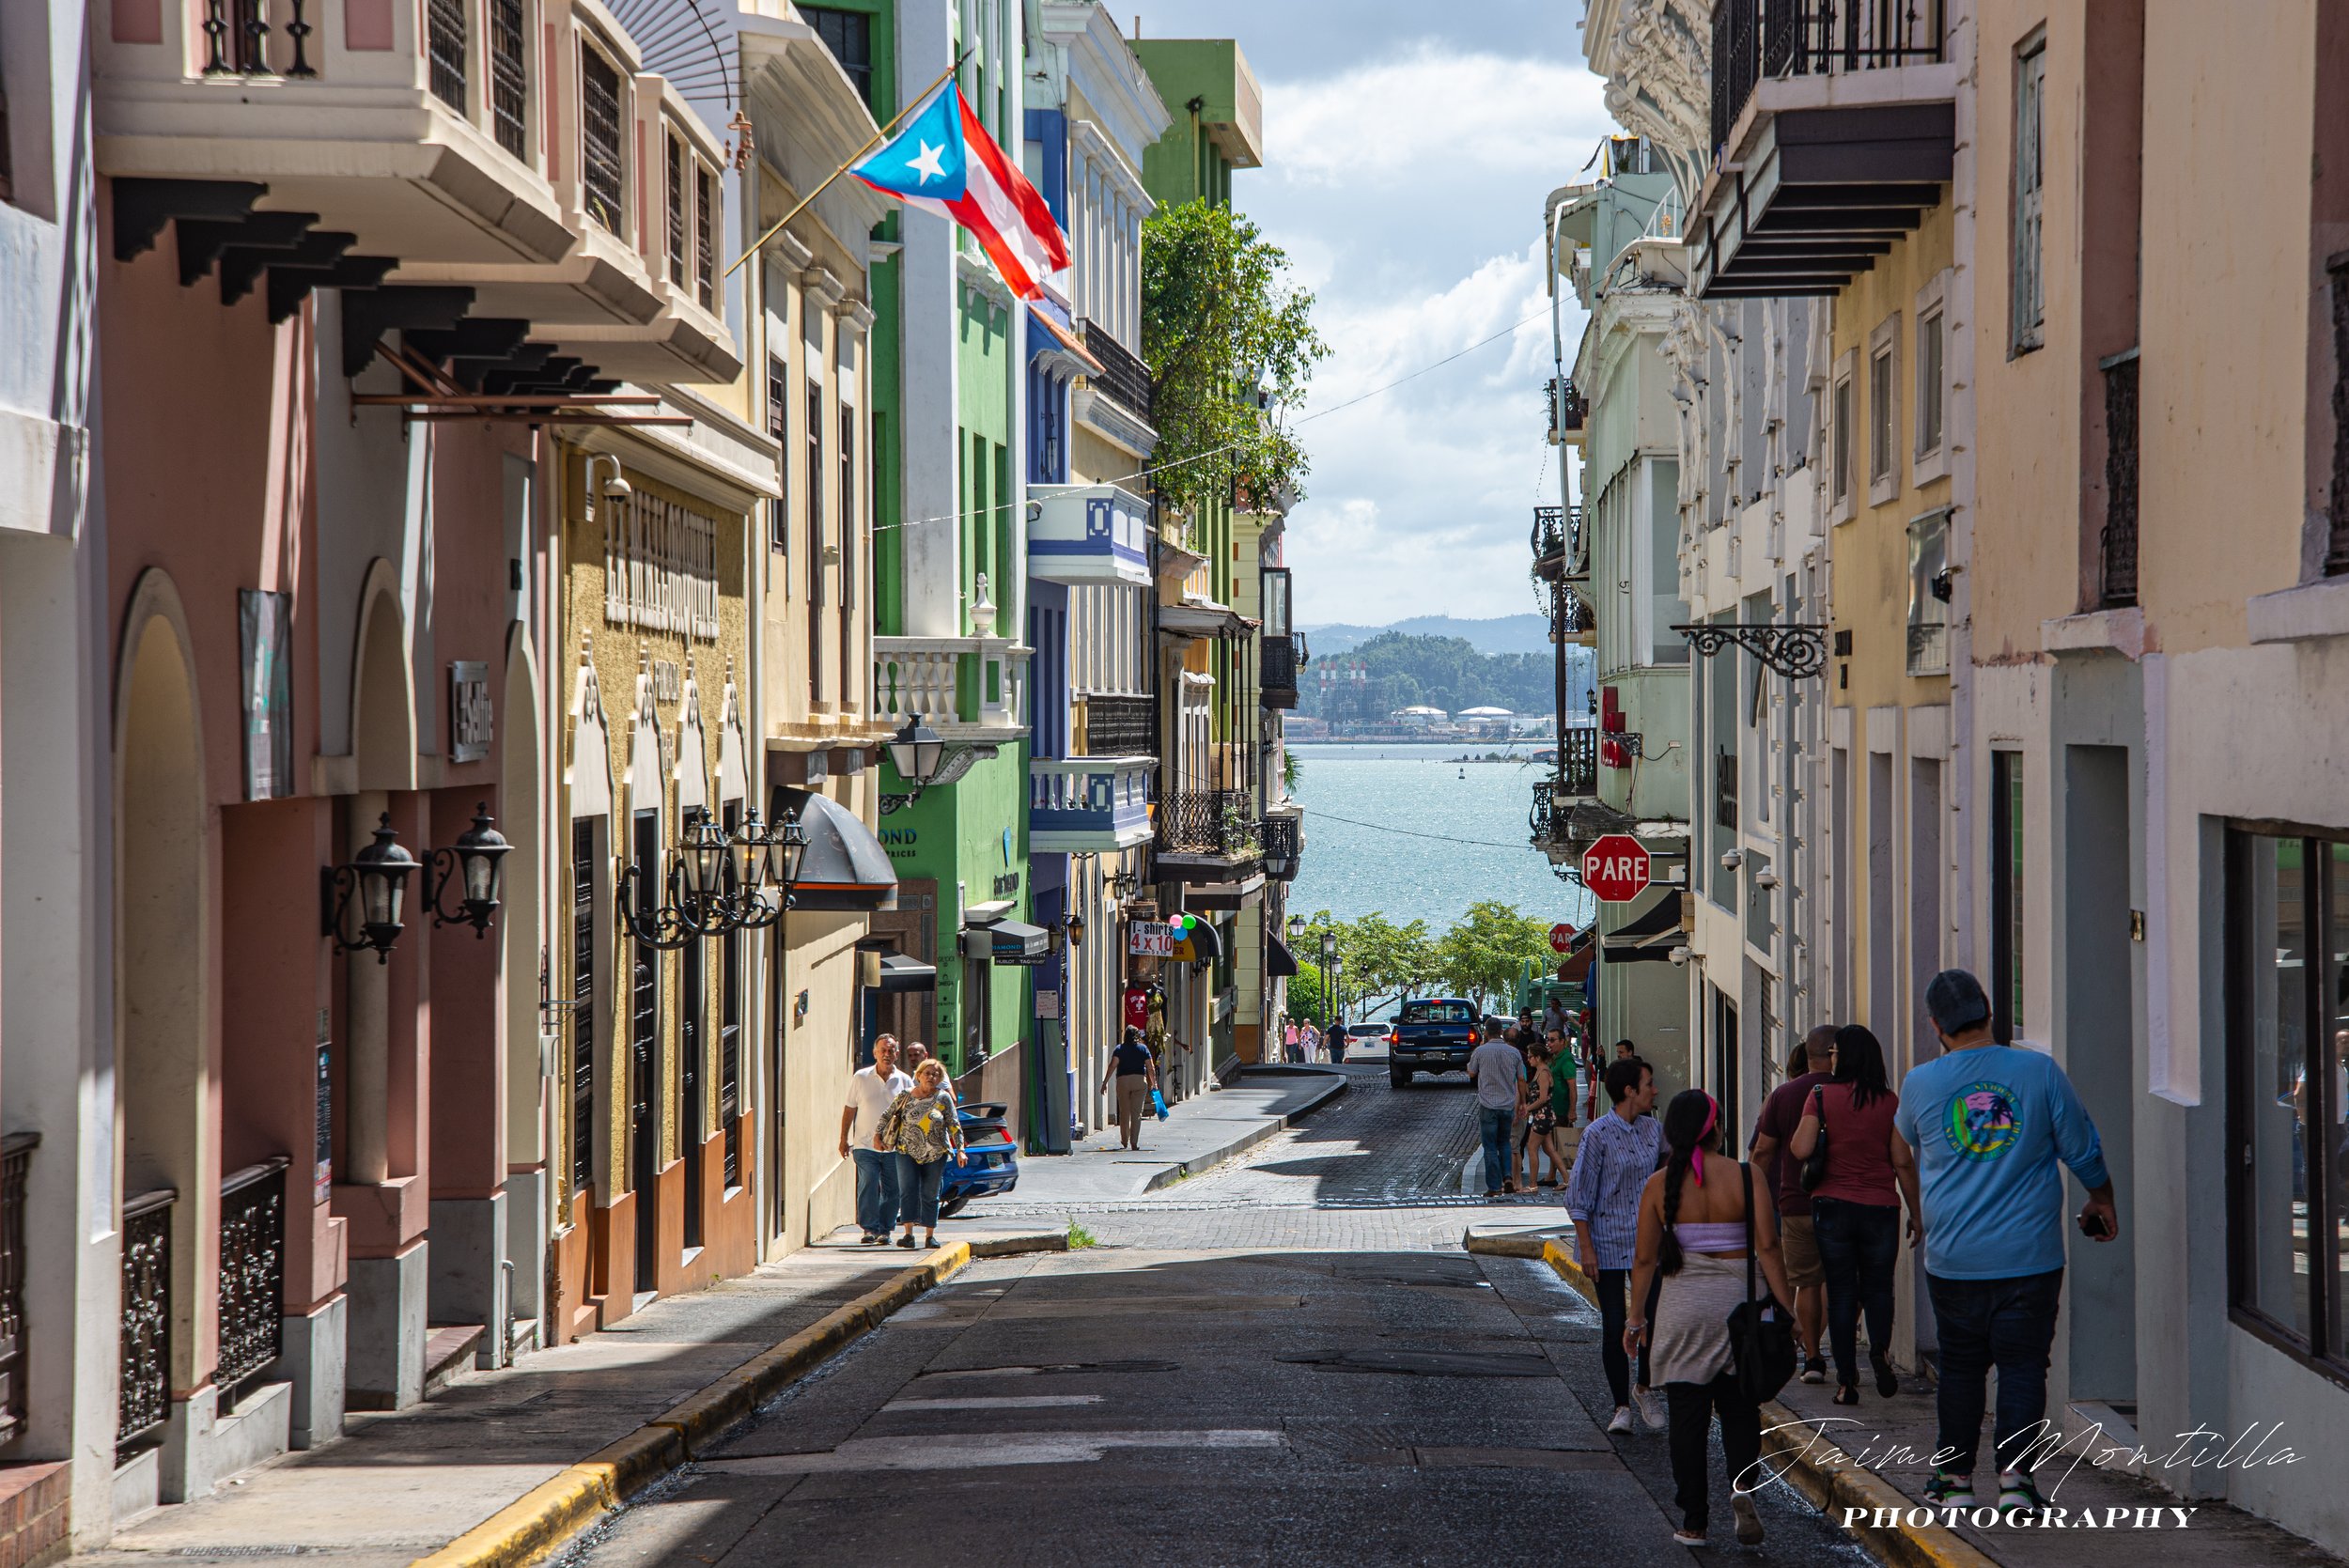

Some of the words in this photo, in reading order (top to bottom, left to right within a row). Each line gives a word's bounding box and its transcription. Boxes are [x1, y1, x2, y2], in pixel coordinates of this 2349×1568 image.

[879, 828, 917, 845] OND
[1586, 856, 1647, 881] PARE
[1144, 924, 1174, 936] shirts
[1131, 934, 1140, 949] 4
[1143, 937, 1152, 950] x
[1158, 935, 1173, 952] 10
[1550, 932, 1573, 944] PAR
[1174, 946, 1184, 955] ER
